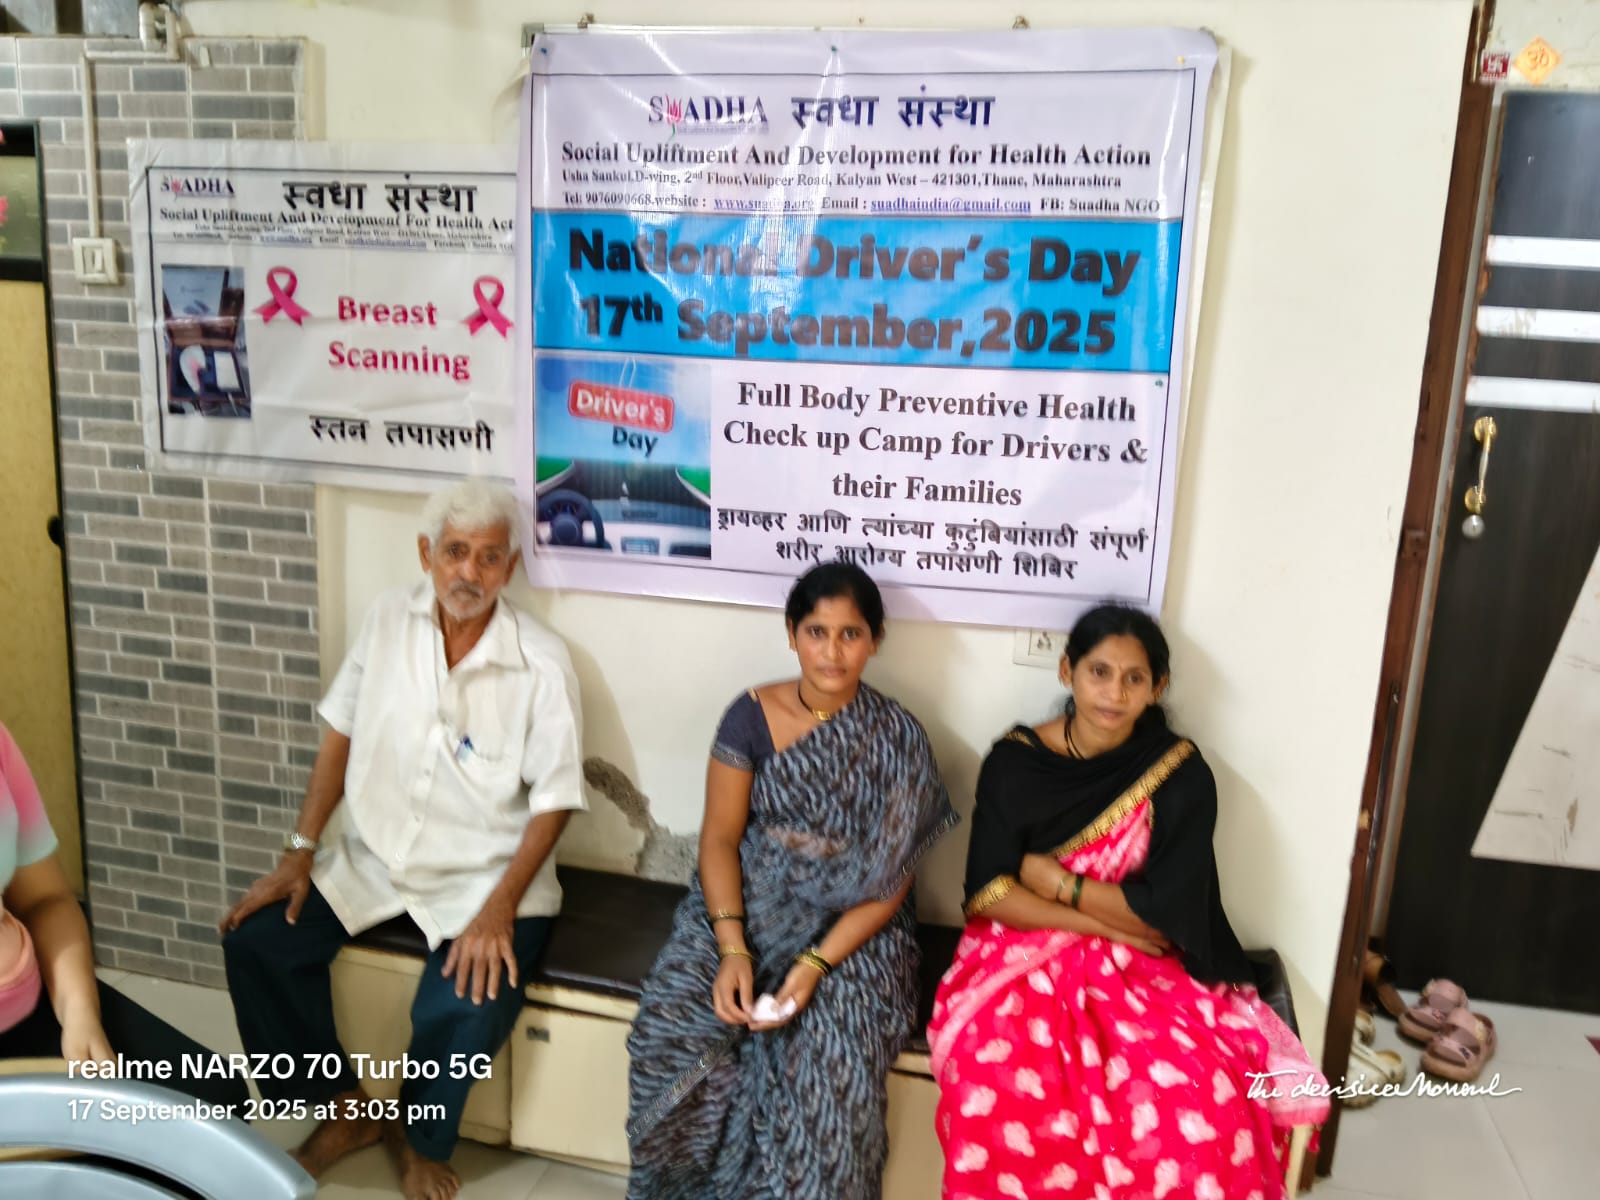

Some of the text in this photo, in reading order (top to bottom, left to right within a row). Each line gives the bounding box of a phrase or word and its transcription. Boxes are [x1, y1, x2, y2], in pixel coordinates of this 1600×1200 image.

[791, 84, 996, 129] स्वधा संस्था
[562, 141, 1151, 170] Social Upliftment And Development for Health Action
[282, 173, 478, 213] स्वधा संस्था
[836, 173, 881, 188] Kalyan
[886, 173, 917, 187] West
[1032, 173, 1122, 188] Maharashtra
[160, 208, 198, 221] Social
[202, 208, 272, 224] Upliftment
[278, 211, 306, 224] And
[406, 214, 430, 227] For
[436, 215, 483, 229] Health
[488, 217, 513, 231] Act
[821, 197, 859, 209] Email
[1070, 199, 1120, 212] Suadha
[1124, 199, 1160, 213] NGO
[569, 228, 778, 277] National
[1028, 236, 1141, 297] Day
[337, 295, 438, 326] Breast
[581, 295, 663, 337] 17th
[329, 340, 471, 382] Scanning
[737, 382, 1136, 422] Full Body Preventive Health
[309, 415, 496, 452] स्तन तपासणी
[612, 426, 658, 456] Day
[723, 420, 1149, 464] Check up Camp for Drivers &
[832, 473, 1022, 506] their Families
[797, 509, 851, 535] आणि
[861, 512, 934, 539] त्यांच्या
[1089, 526, 1149, 560] संपूर्ण
[776, 537, 1078, 580] शरीर आरोग्य तपासणी शिबिर
